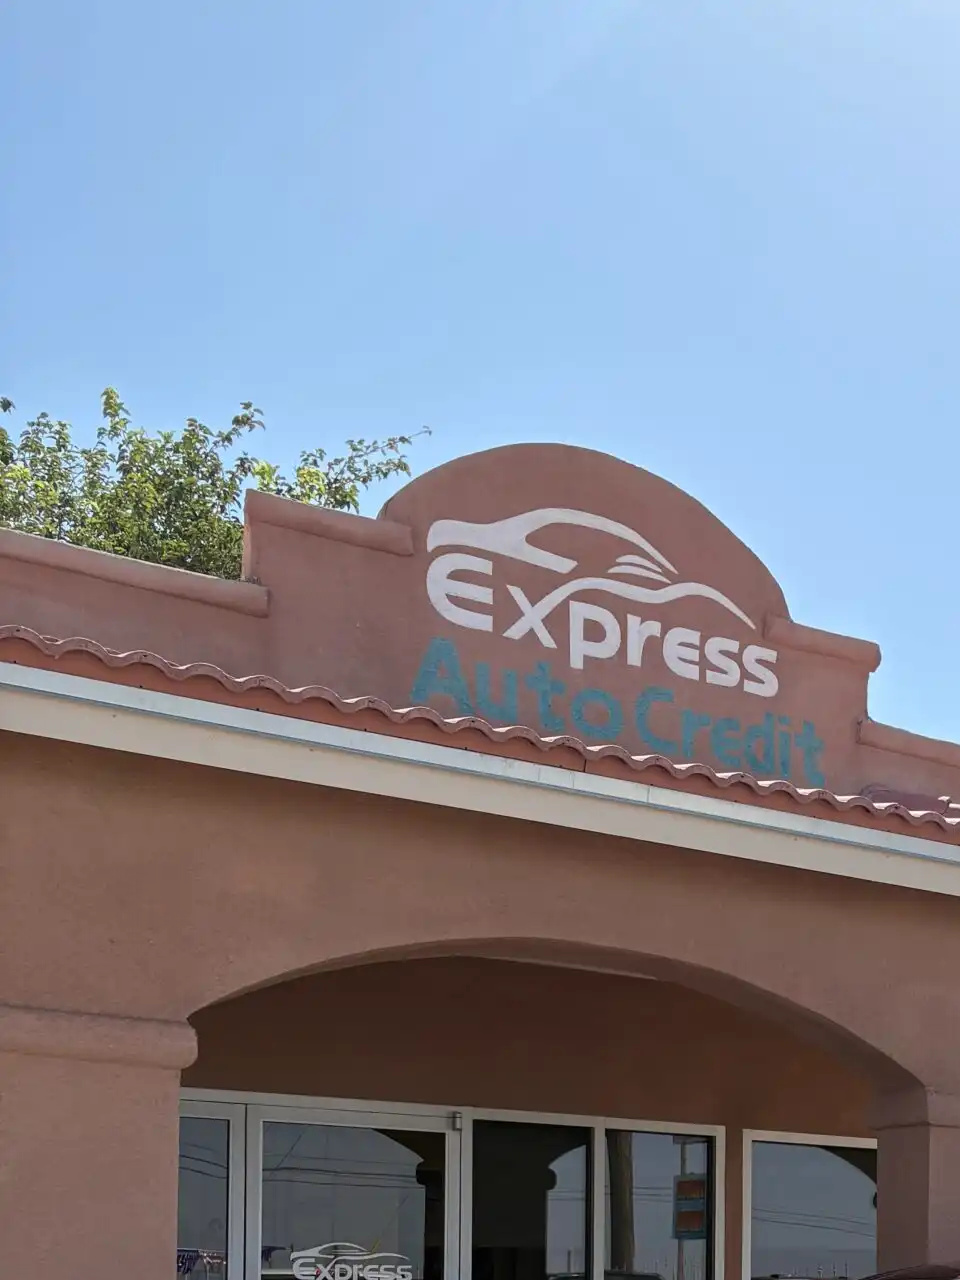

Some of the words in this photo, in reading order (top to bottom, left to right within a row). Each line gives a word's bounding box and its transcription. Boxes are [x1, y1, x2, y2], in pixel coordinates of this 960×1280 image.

[426, 552, 780, 698] Express
[410, 636, 624, 743] Auto
[634, 686, 826, 788] Credit
